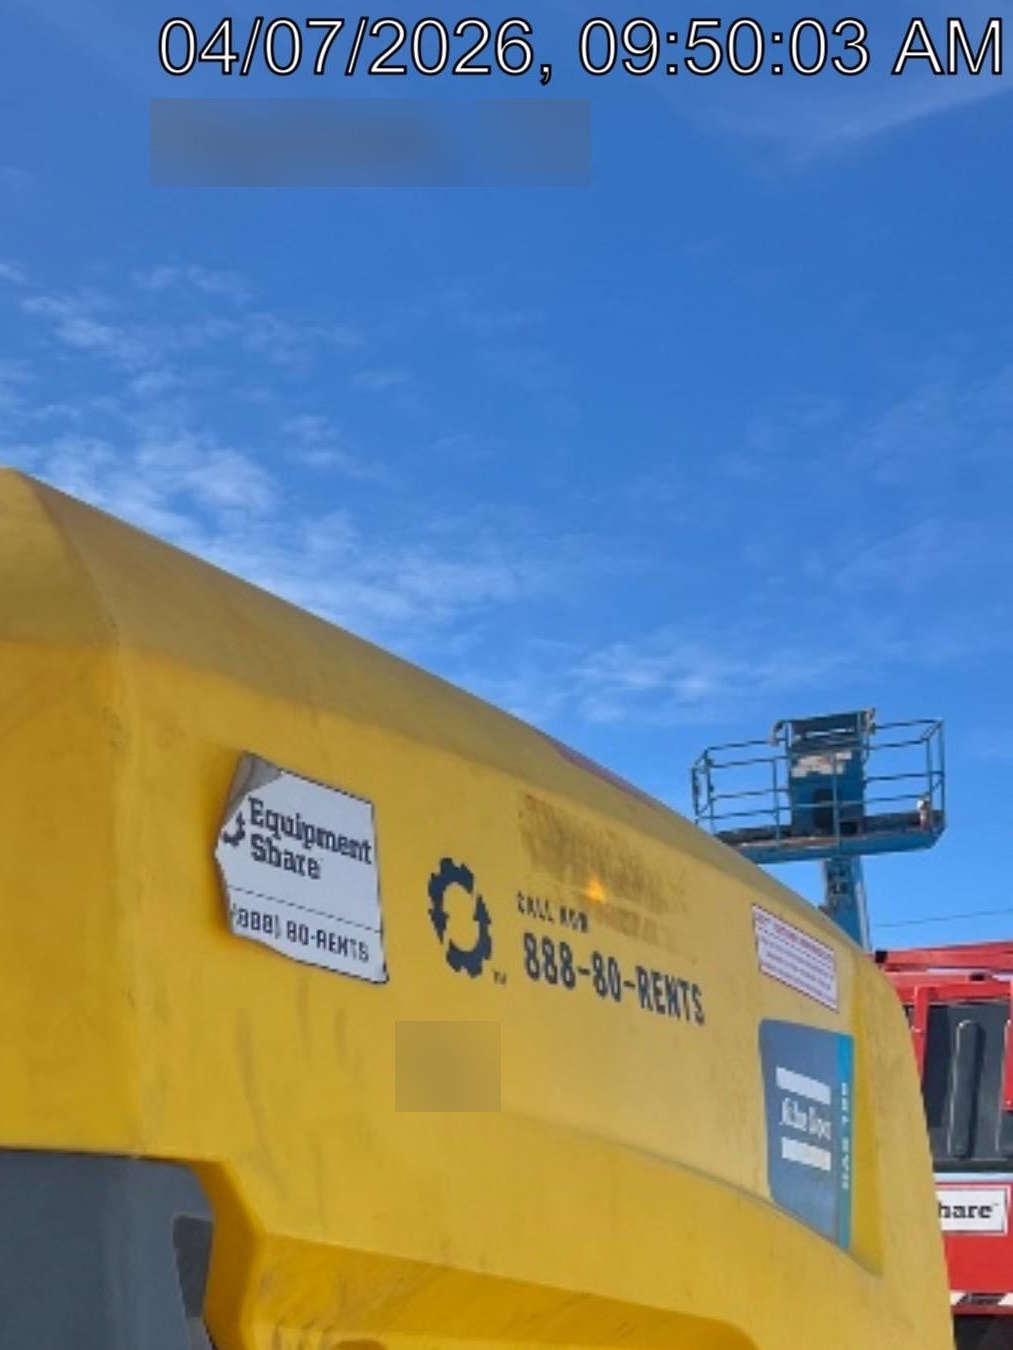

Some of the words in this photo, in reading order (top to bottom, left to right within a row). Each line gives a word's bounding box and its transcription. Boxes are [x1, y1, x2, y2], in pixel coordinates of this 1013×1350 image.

[248, 797, 373, 865] Equipment
[250, 833, 322, 880] Share
[517, 890, 554, 924] CALL
[286, 919, 370, 964] 80-RENTS
[523, 931, 706, 1025] 888-80-RENTS
